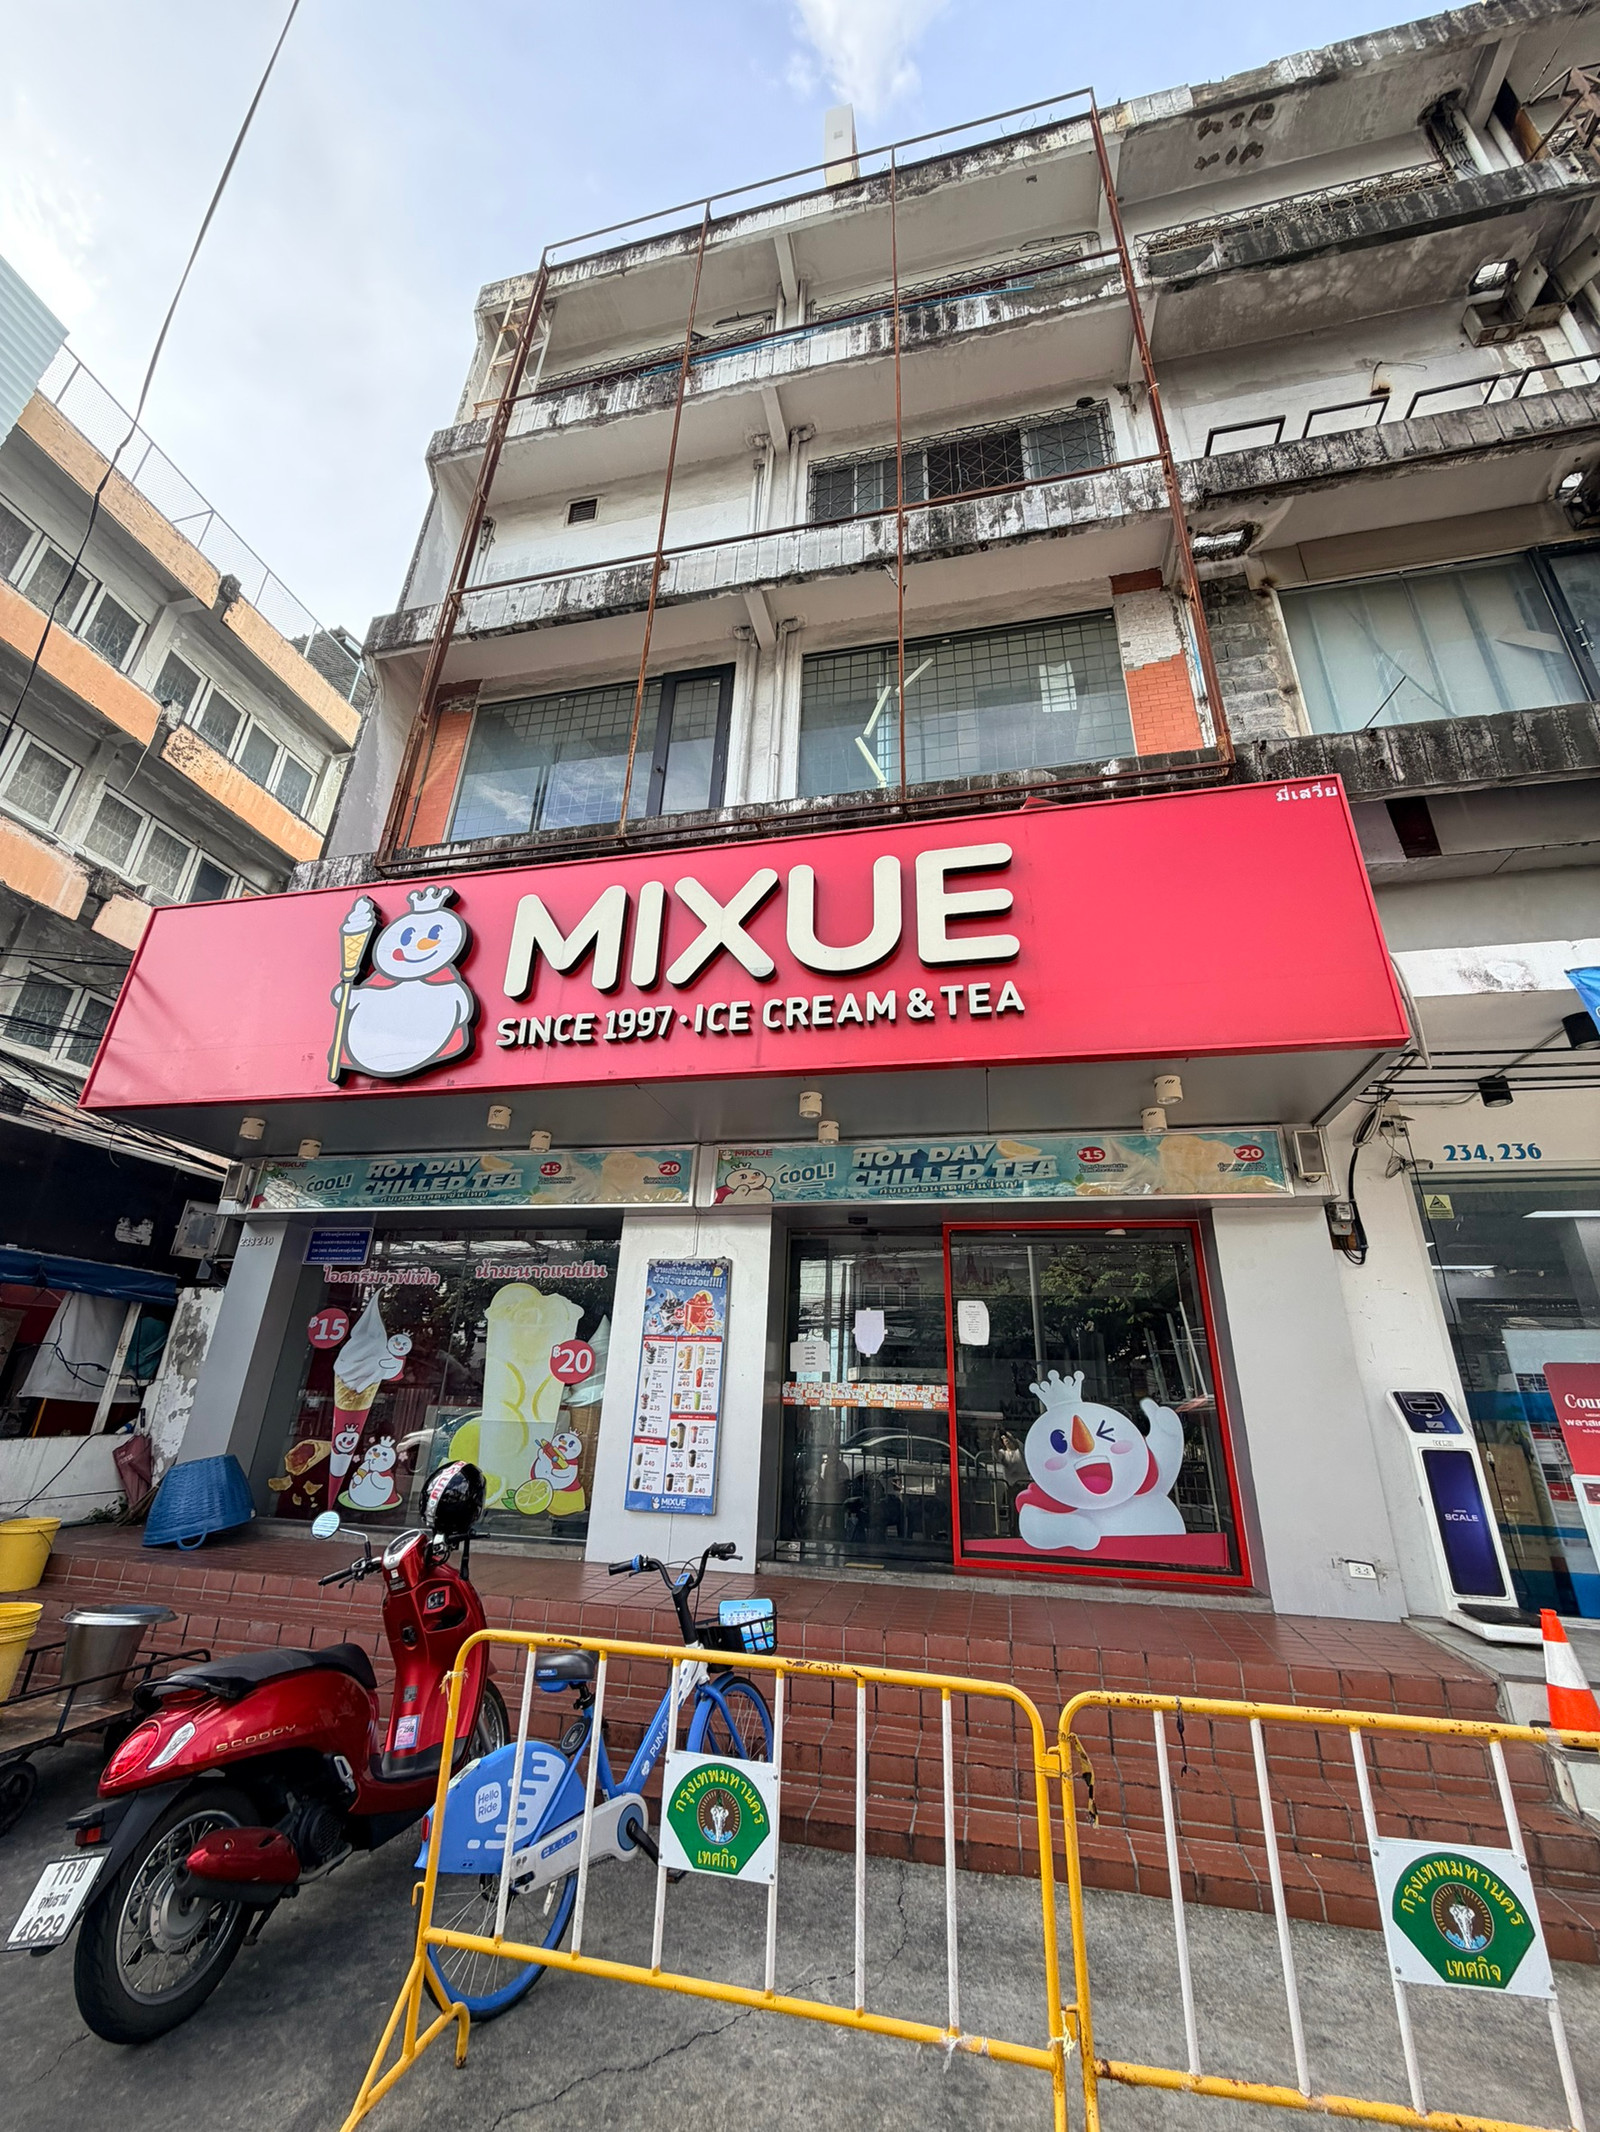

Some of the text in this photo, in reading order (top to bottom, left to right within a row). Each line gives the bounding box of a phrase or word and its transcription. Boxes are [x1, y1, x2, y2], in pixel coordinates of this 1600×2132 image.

[503, 842, 1021, 998] MIXUE
[496, 1013, 595, 1046] SINCE
[603, 1005, 673, 1040] 1997
[694, 1001, 752, 1033] ICE
[763, 990, 896, 1028] CREAM
[906, 987, 935, 1019] &
[940, 980, 1025, 1016] TEA
[734, 1149, 773, 1157] MIXUE
[852, 1143, 997, 1168] HOT DAY
[1443, 1142, 1542, 1162] 234, 236
[366, 1158, 480, 1179] HOT DAY
[779, 1163, 835, 1184] COOL!
[849, 1164, 985, 1186] CHILLED
[993, 1160, 1057, 1178] TEA
[307, 1174, 354, 1193] COOL!
[362, 1175, 467, 1194] CHILLED
[469, 1170, 522, 1189] TEA
[256, 1236, 274, 1246] 240
[323, 1265, 440, 1289] ไอศกรีมวาฟเฟิล
[475, 1260, 607, 1279] น้ำมะนาวแช่เย็น
[999, 1399, 1041, 1415] MIXU
[661, 1498, 687, 1507] MIXUE
[1444, 1513, 1479, 1522] SCALE
[216, 1724, 296, 1752] SCOOPY
[478, 1789, 499, 1805] Hello
[675, 1769, 764, 1825] กรุงเทพมหานคร
[478, 1801, 498, 1817] Ride
[697, 1847, 738, 1869] เทศกิจ
[1401, 1860, 1525, 1926] กรุงเทพมหานคร
[16, 1913, 65, 1941] 4629
[1446, 1955, 1502, 1982] เทศกิจ
